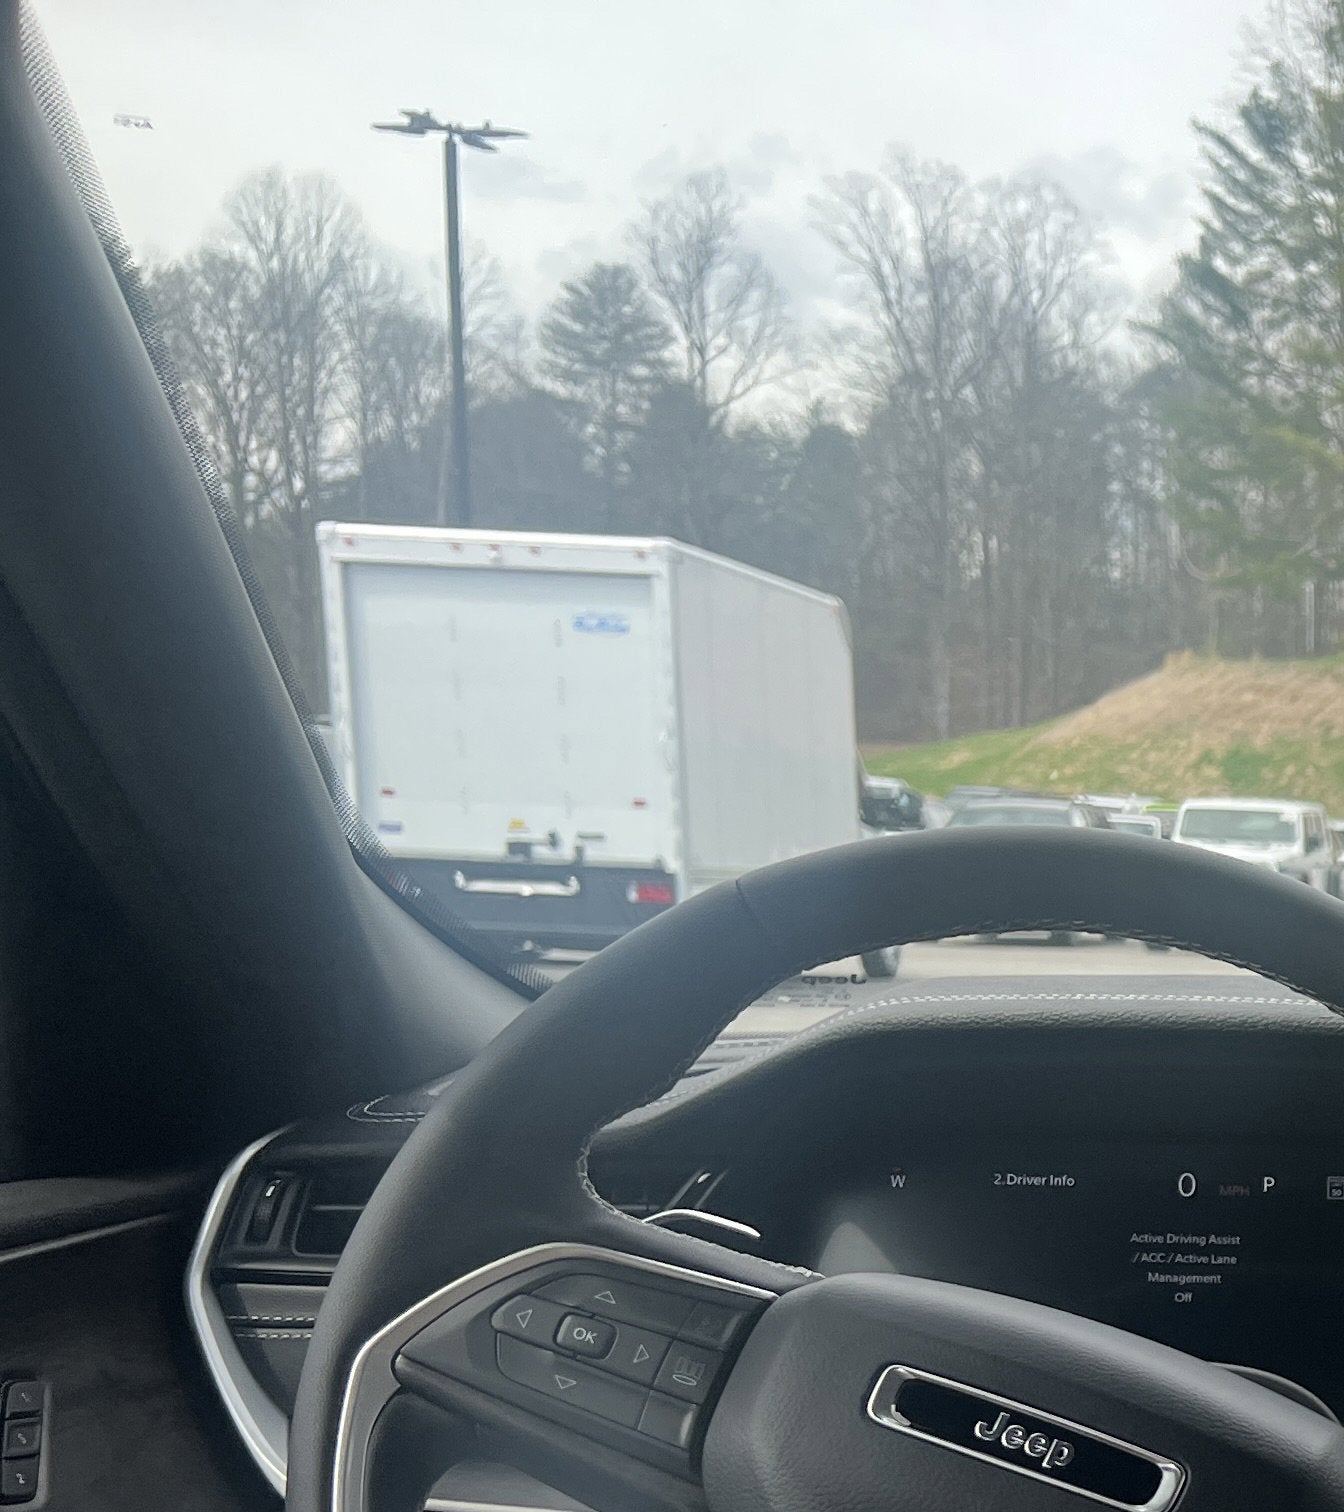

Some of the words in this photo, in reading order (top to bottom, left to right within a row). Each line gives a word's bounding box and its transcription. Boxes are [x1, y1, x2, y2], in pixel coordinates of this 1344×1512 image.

[890, 1175, 906, 1188] W
[1006, 1173, 1048, 1186] Driver
[1050, 1174, 1075, 1187] Info
[1178, 1174, 1196, 1197] 0
[1263, 1176, 1276, 1192] P
[1130, 1233, 1164, 1244] Active
[1166, 1233, 1207, 1247] Driving
[1208, 1234, 1241, 1245] Assist
[1141, 1252, 1166, 1263] ACC
[1175, 1253, 1209, 1264] Active
[1211, 1254, 1238, 1265] Lane
[1147, 1271, 1222, 1286] Management
[1174, 1292, 1193, 1303] Off
[572, 1327, 598, 1344] OK
[973, 1411, 1075, 1469] Jeep
